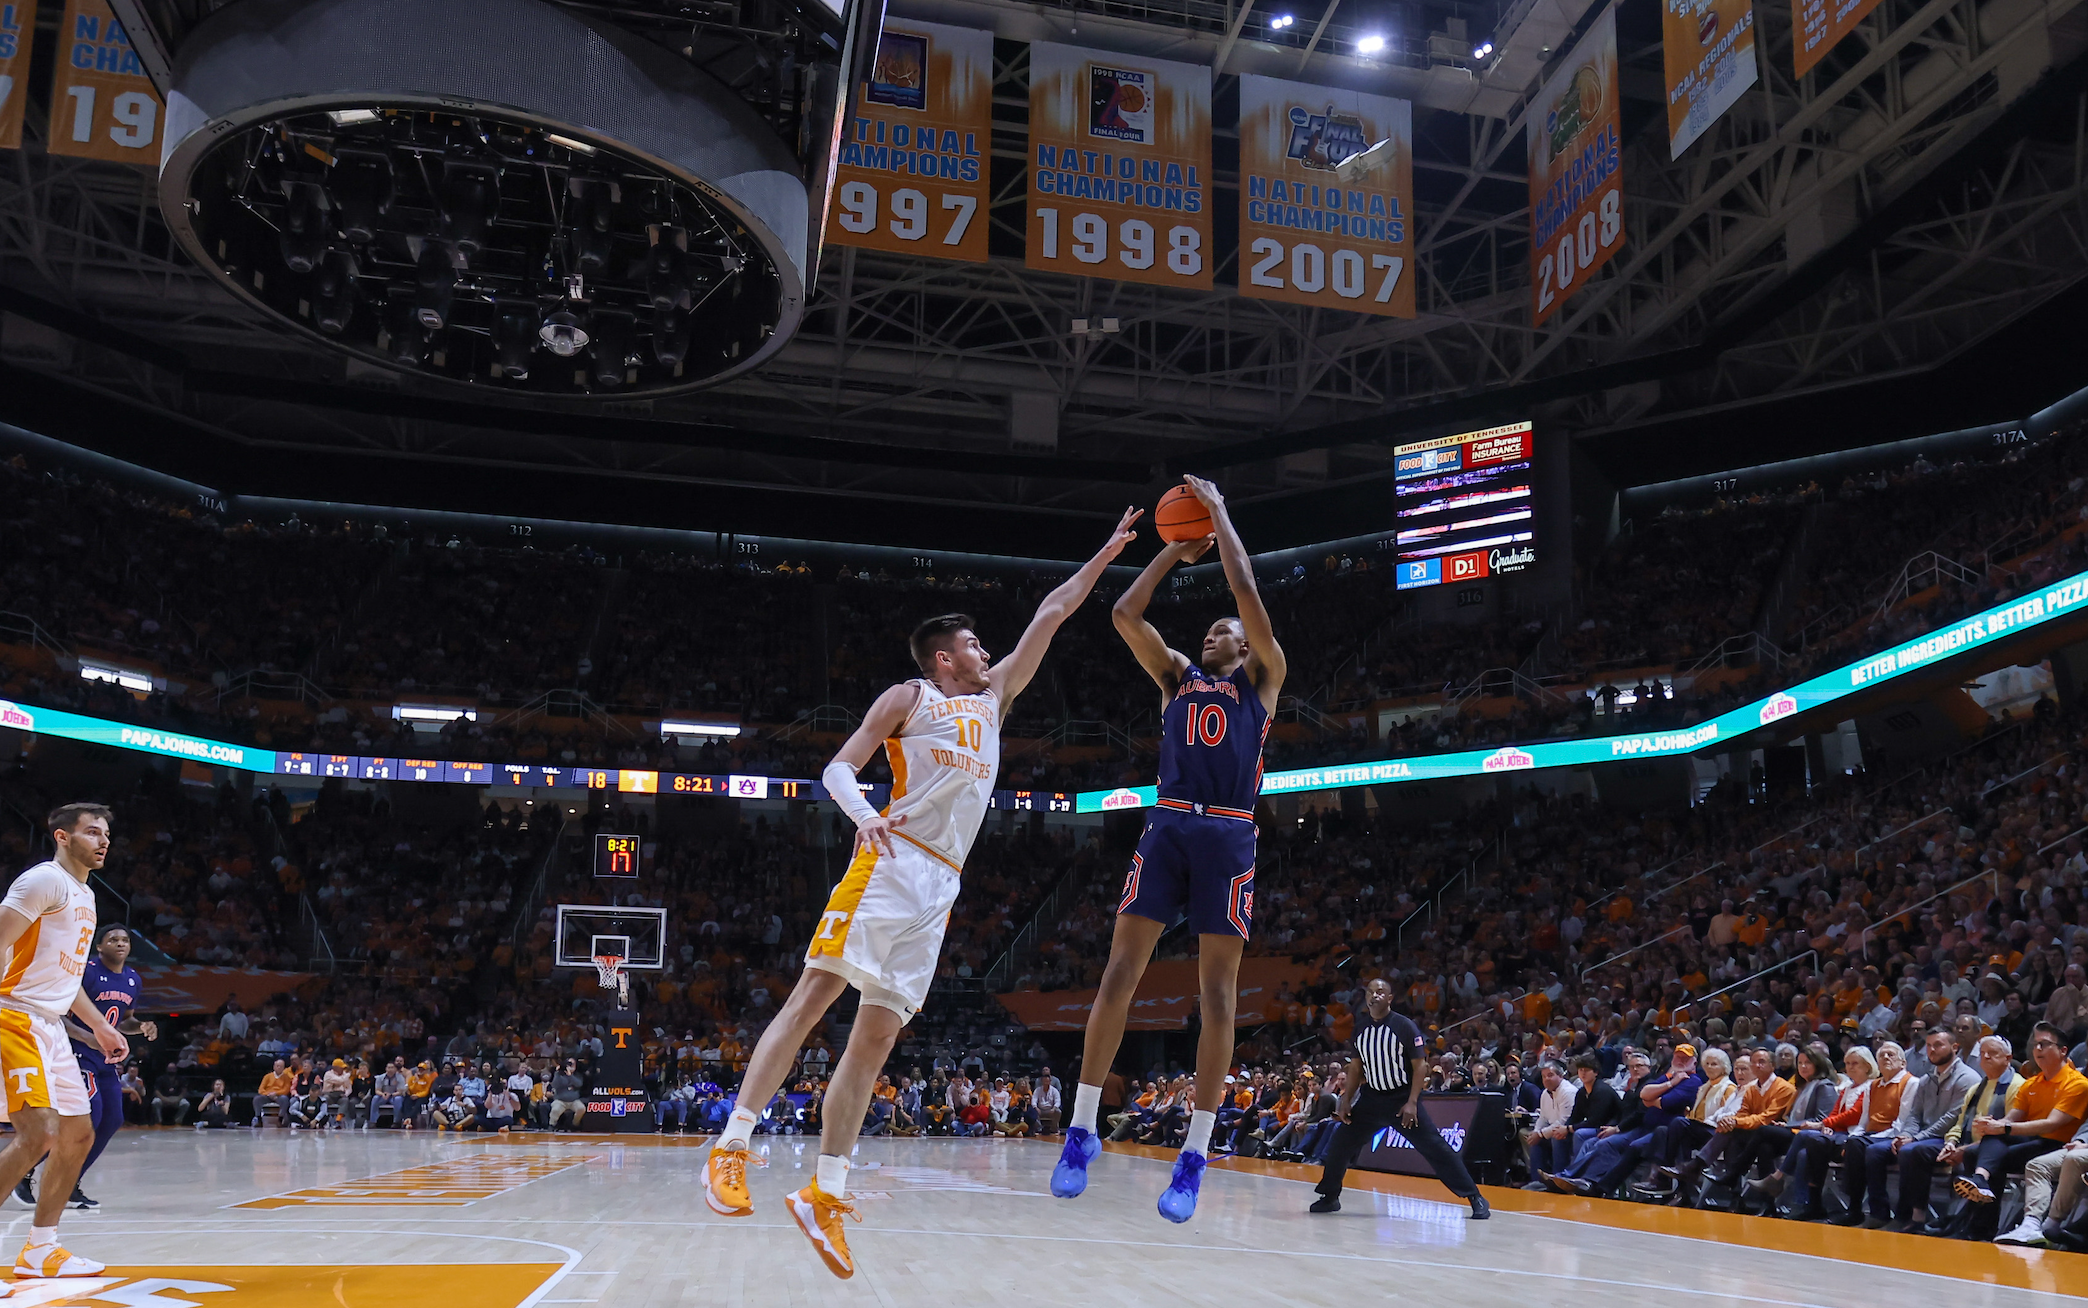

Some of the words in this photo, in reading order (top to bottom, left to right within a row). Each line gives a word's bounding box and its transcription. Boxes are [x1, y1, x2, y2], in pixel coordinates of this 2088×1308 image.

[1670, 69, 1696, 105] NCAA
[1699, 9, 1753, 77] REGIONALS
[1115, 71, 1142, 83] NCAA
[68, 86, 157, 148] 19
[854, 117, 981, 157] TIONAL
[840, 142, 981, 182] AMPIONS
[1037, 143, 1203, 188] NATIONAL
[1535, 123, 1618, 226] NATIONAL
[1036, 169, 1202, 214] CHAMPIONS
[1248, 174, 1405, 221] NATIONAL
[1536, 147, 1620, 249] CHAMPIONS
[839, 180, 977, 246] 997
[1248, 200, 1405, 244] CHAMPIONS
[1036, 207, 1202, 276] 1998
[1538, 188, 1621, 314] 2008
[1251, 237, 1404, 304] 2007
[1401, 437, 1454, 452] UNIVERSITY
[1457, 434, 1469, 442] OF
[1471, 424, 1524, 439] TENNESSEE
[1472, 441, 1493, 452] Farm
[1494, 436, 1522, 448] Bureau
[1992, 429, 2027, 446] 317A
[1398, 457, 1423, 471] FOOD
[1437, 450, 1458, 464] CITY
[1713, 478, 1737, 492] 317
[197, 494, 225, 513] 311A
[509, 524, 532, 537] 312
[737, 542, 759, 554] 313
[1376, 538, 1396, 552] 315
[912, 557, 933, 568] 314
[1503, 565, 1525, 573] HOTELS
[1851, 654, 1897, 687] BETTER
[1898, 620, 1987, 669] INGREDIENTS.
[1987, 597, 2045, 635] BETTER
[2046, 578, 2088, 613] PIZZA
[1174, 678, 1240, 706] AUBURN
[928, 698, 994, 728] TENNESSEE
[1186, 702, 1228, 747] 10
[954, 717, 982, 753] 10
[1611, 722, 1719, 756] PAPAJOHNS.COM
[120, 727, 245, 765] PAPAJOHNS.COM
[291, 752, 303, 761] FG
[373, 757, 385, 766] FT
[405, 759, 421, 768] DEF
[421, 760, 437, 769] REB
[452, 761, 468, 770] OFF
[468, 762, 484, 771] REB
[414, 768, 428, 781] 10
[504, 764, 530, 774] FOULS
[1262, 773, 1323, 791] REDIENTS.
[1323, 767, 1370, 785] BETTER
[1372, 762, 1412, 780] PIZZA.
[512, 773, 522, 786] 4
[545, 774, 555, 787] 4
[587, 771, 607, 789] 18
[673, 776, 714, 793] 8:21
[782, 781, 798, 798] 11
[1054, 792, 1065, 800] FG
[607, 839, 635, 852] 8:21
[611, 852, 630, 873] 17
[592, 1086, 644, 1097] ALLVOLS.COM
[587, 1101, 611, 1113] FOOD
[625, 1101, 646, 1113] CITY
